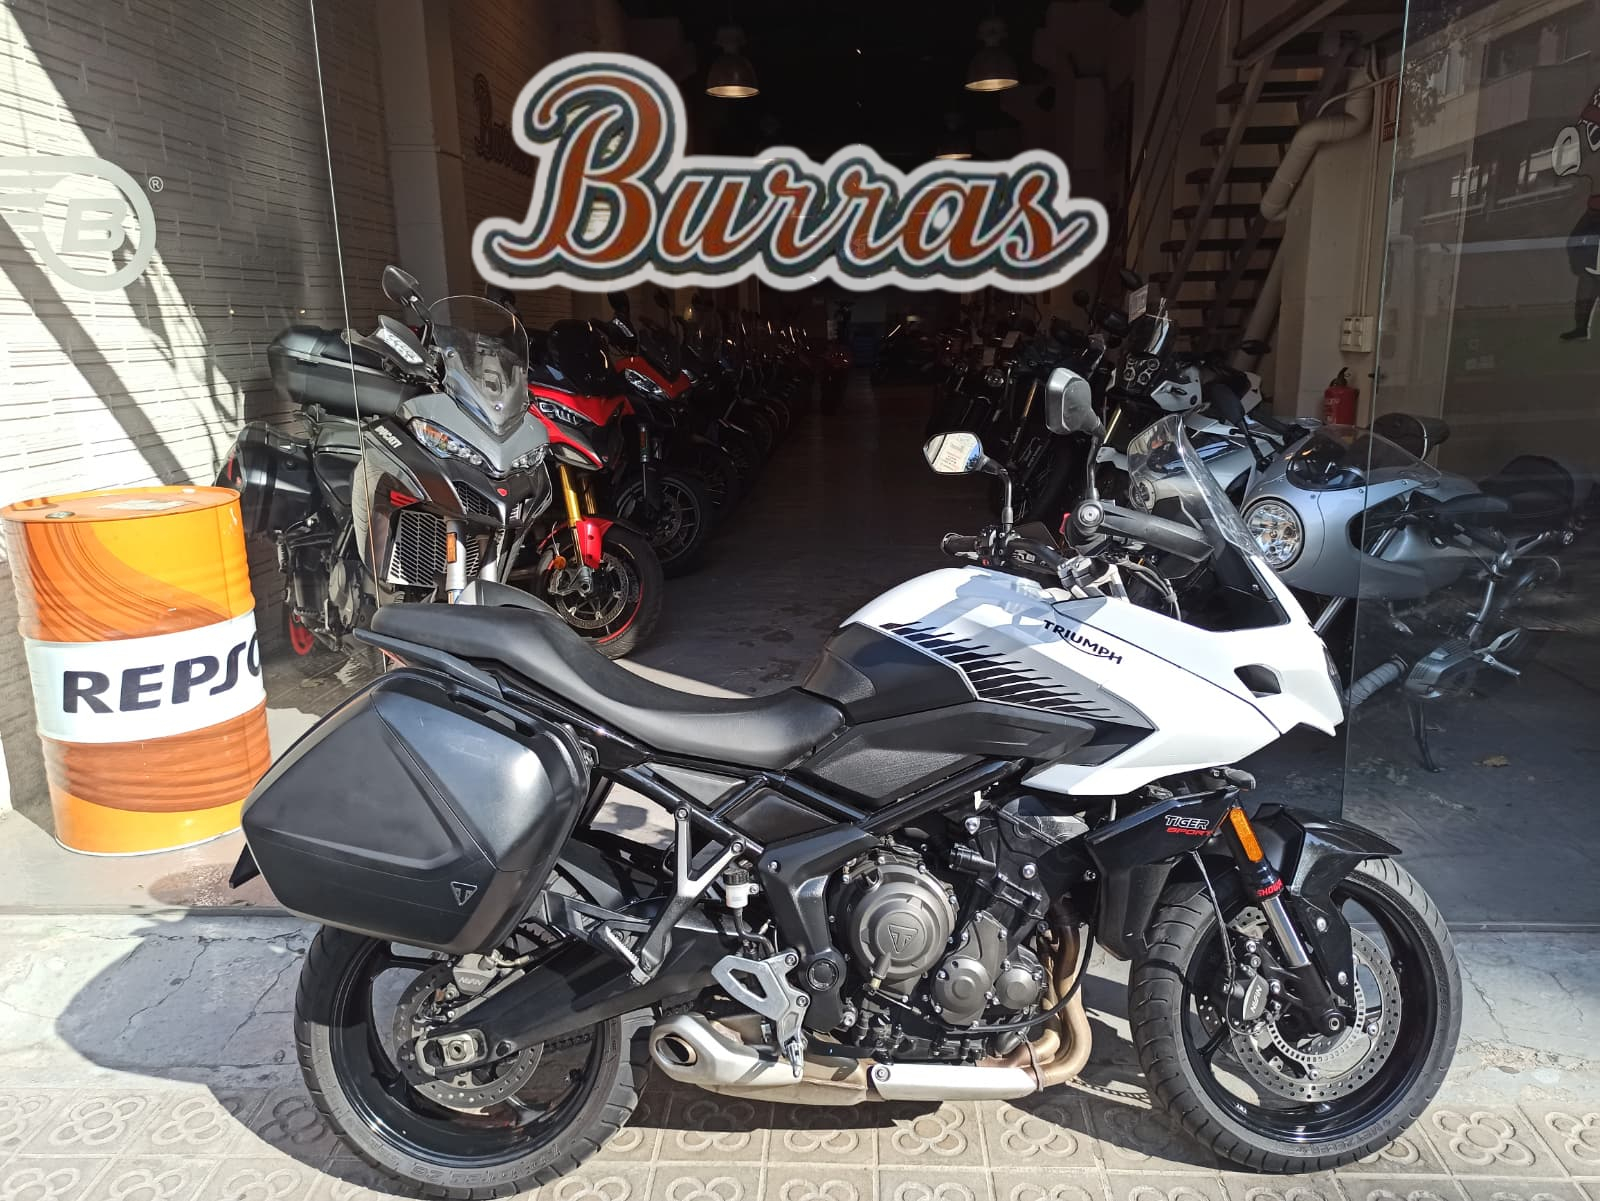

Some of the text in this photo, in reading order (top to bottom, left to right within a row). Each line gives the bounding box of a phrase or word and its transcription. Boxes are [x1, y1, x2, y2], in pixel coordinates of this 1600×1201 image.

[374, 425, 402, 448] DUCATI
[1043, 619, 1123, 665] TRIUMPH
[1165, 814, 1210, 830] TIGER
